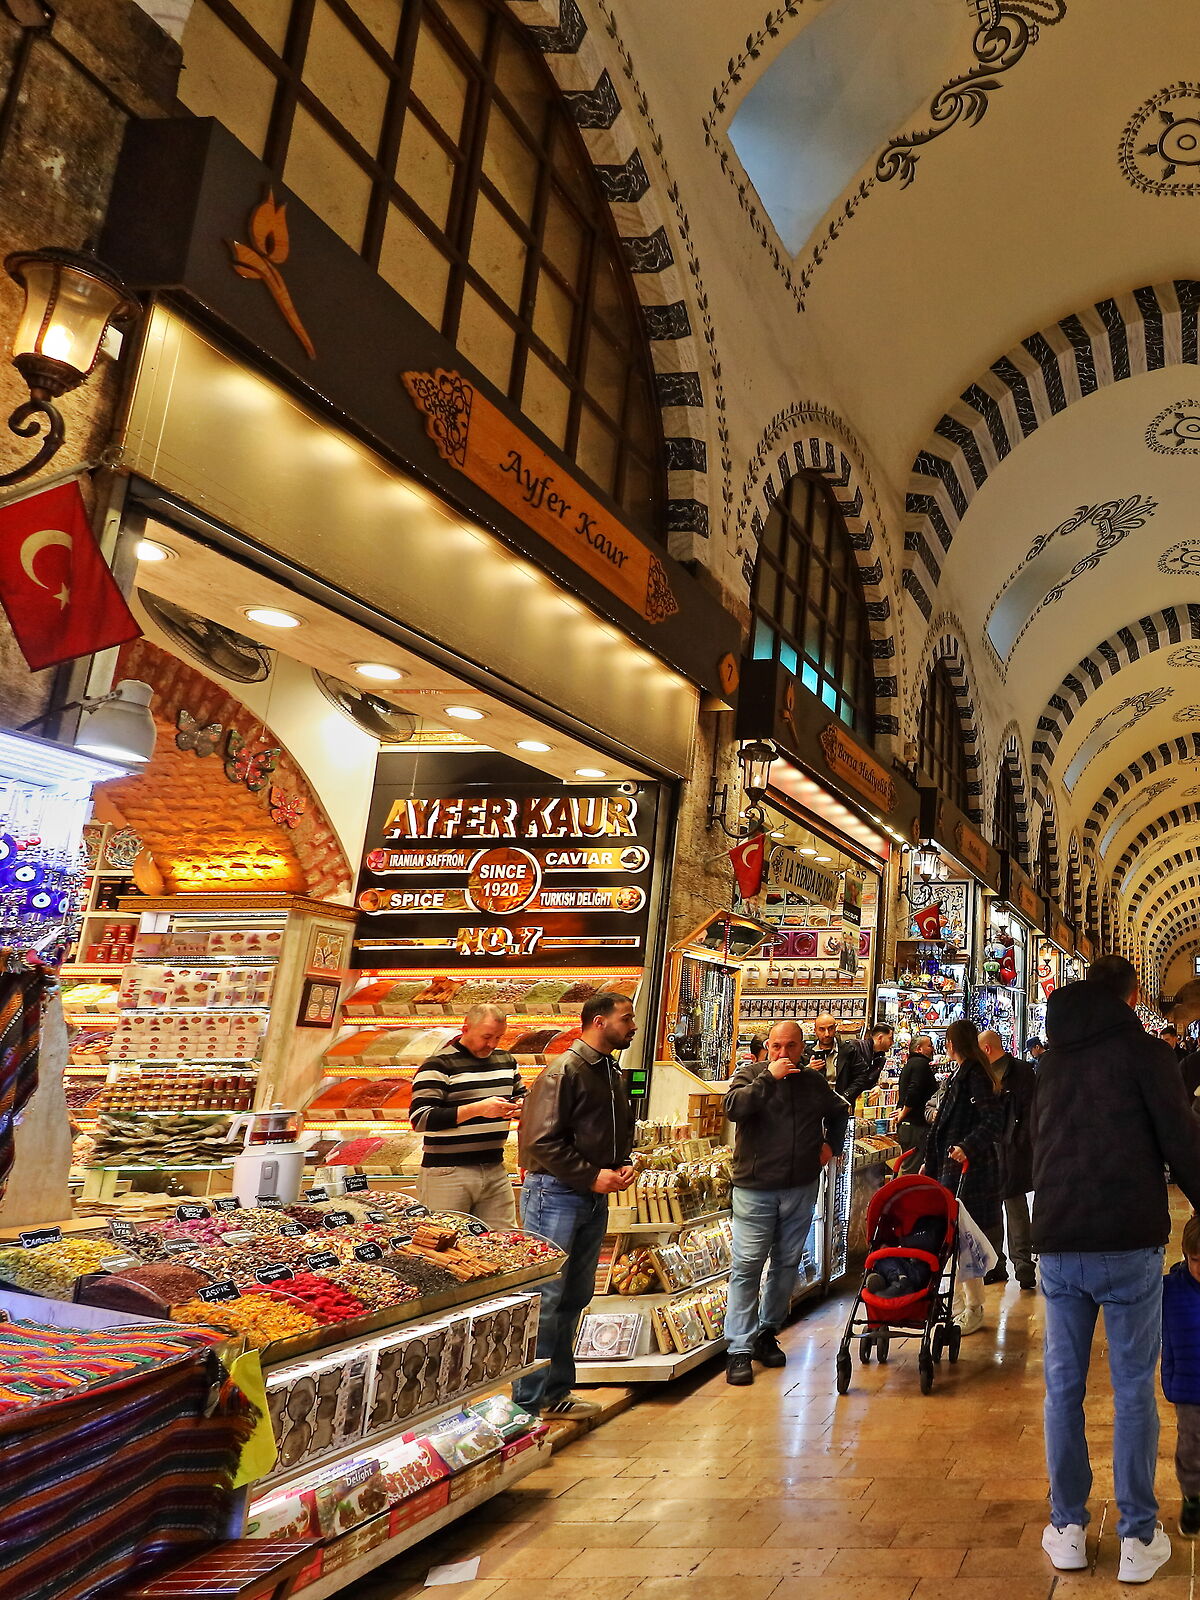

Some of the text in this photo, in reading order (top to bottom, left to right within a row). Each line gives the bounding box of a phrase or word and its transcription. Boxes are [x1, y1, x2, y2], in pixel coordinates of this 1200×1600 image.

[499, 450, 629, 569] Ayfer Kaur
[727, 663, 733, 682] 7
[837, 741, 858, 770] Borsa
[384, 796, 642, 839] AYFER KAUR
[389, 853, 465, 868] IRANIAN SAFFRON
[545, 852, 613, 866] CAVIAR
[479, 864, 527, 880] SINCE
[482, 882, 519, 897] 1920
[390, 893, 445, 907] SPICE
[540, 892, 613, 907] TURKISH DELIGHT
[345, 1468, 374, 1487] Delight
